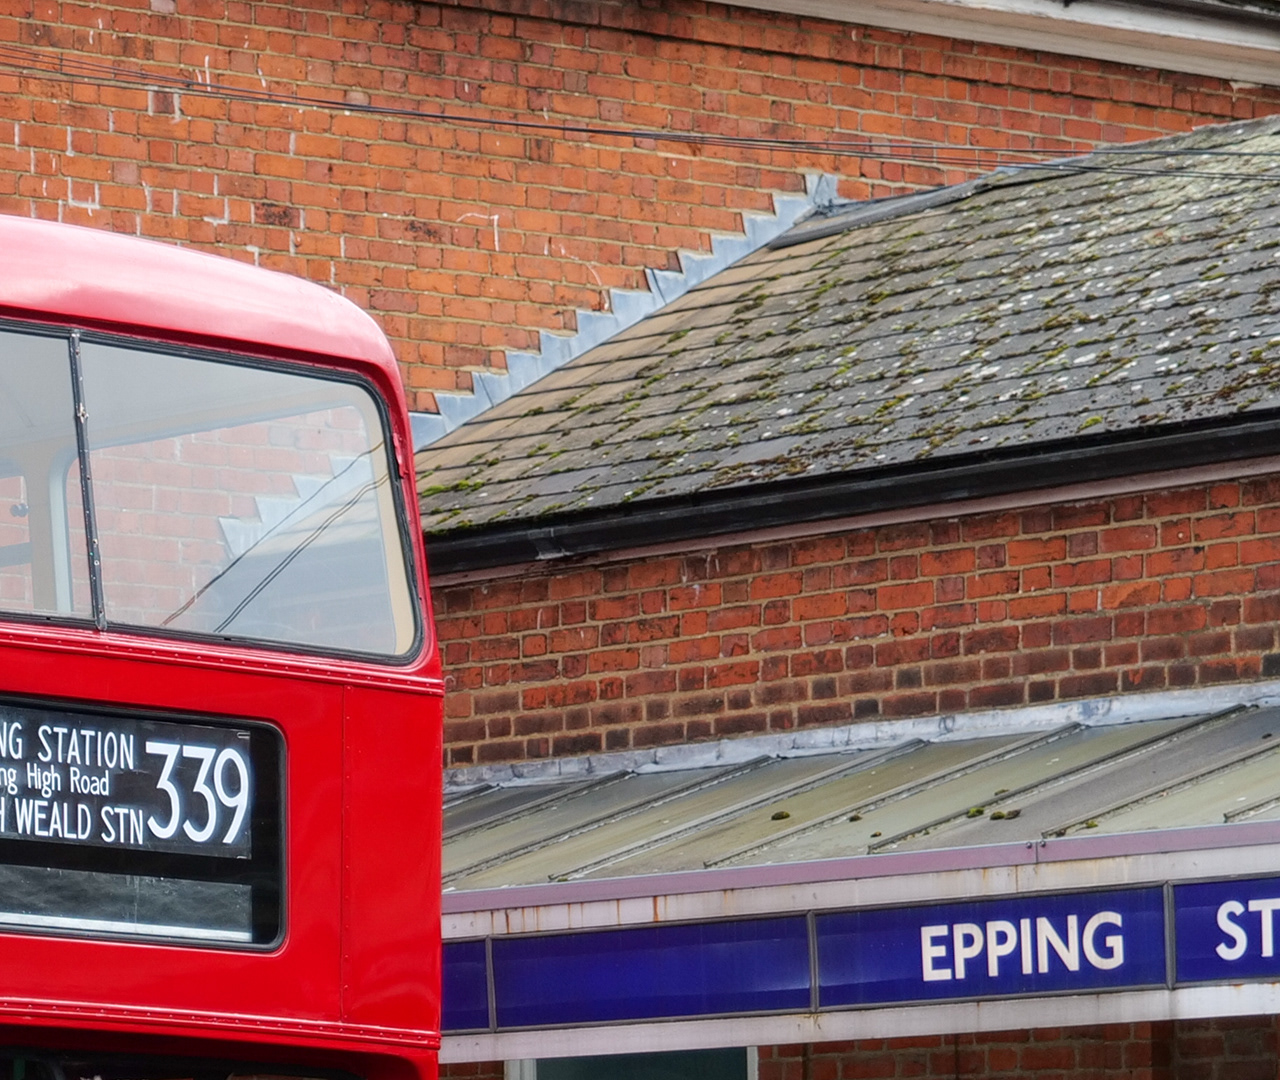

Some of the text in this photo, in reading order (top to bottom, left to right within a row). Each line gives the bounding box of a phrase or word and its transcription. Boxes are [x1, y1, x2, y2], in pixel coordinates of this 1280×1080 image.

[37, 724, 134, 770] STATION
[26, 762, 61, 798] High
[70, 766, 110, 796] Road
[145, 740, 249, 845] 339
[14, 798, 92, 840] WEALD
[99, 805, 144, 845] STN
[920, 910, 1124, 982] EPPING
